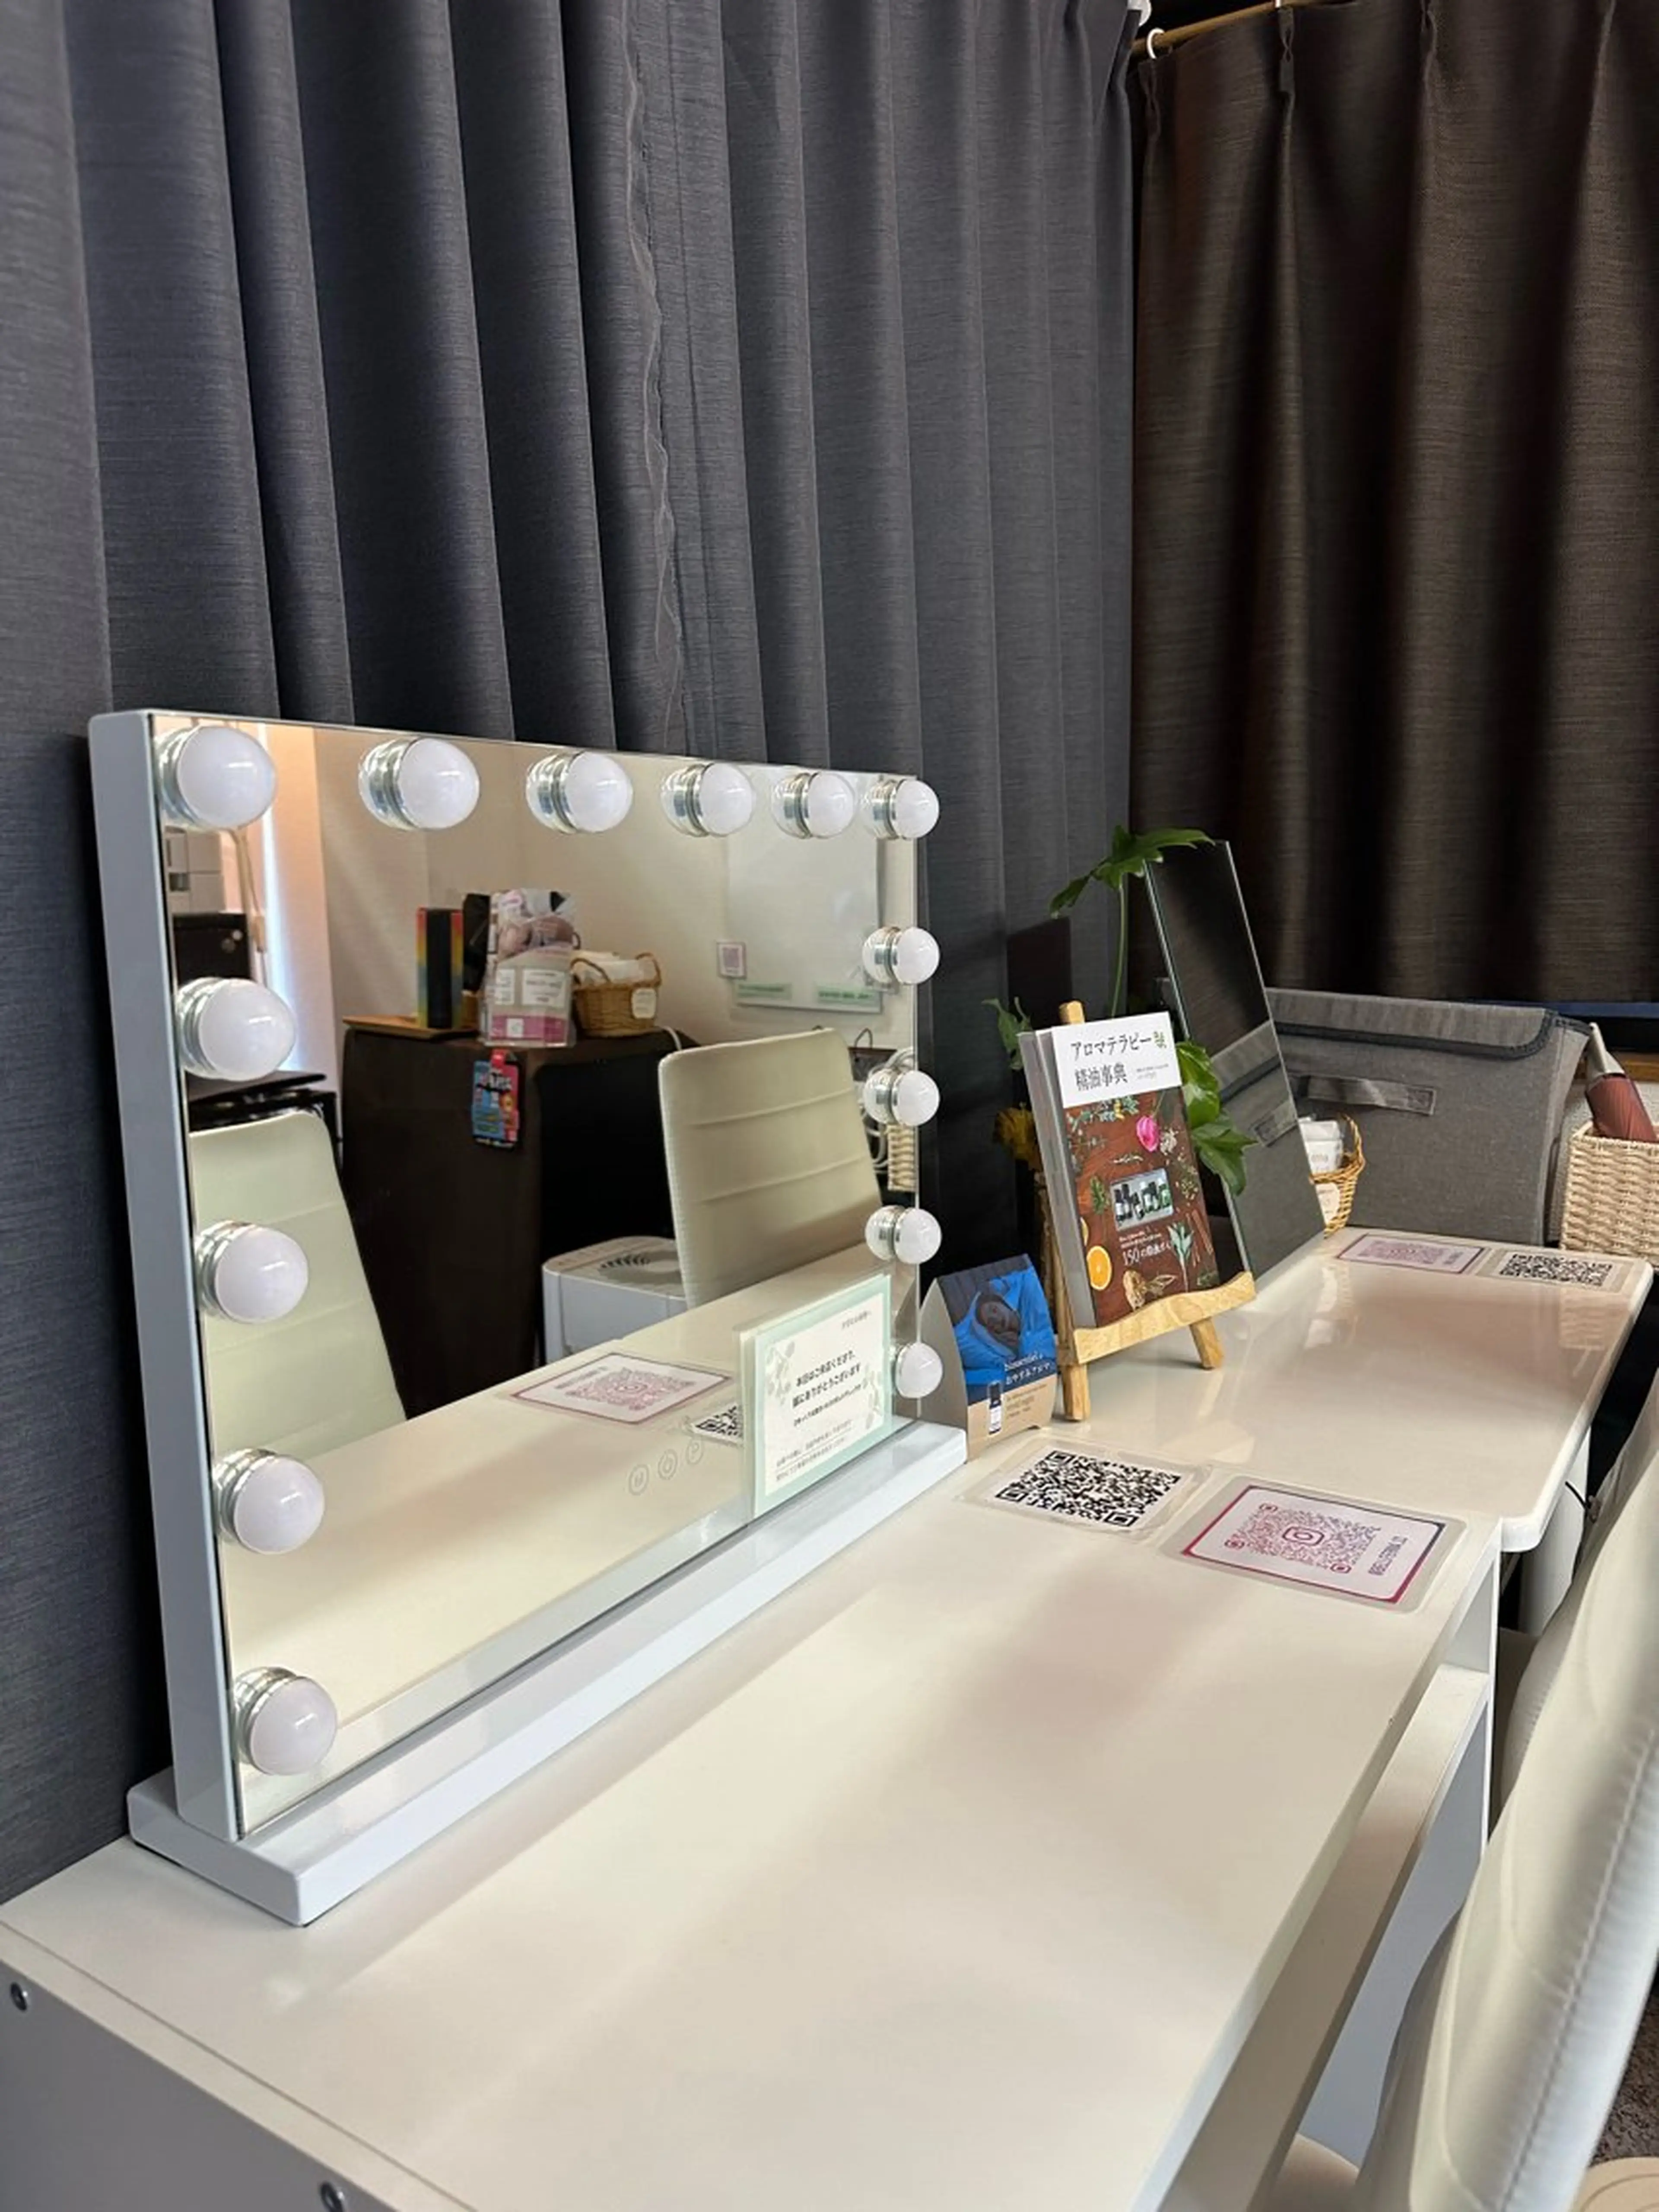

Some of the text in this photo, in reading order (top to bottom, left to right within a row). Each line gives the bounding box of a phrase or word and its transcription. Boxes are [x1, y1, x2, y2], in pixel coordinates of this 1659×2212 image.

[1071, 1033, 1151, 1061] アロマテラピー
[1074, 1062, 1128, 1090] 精油事典
